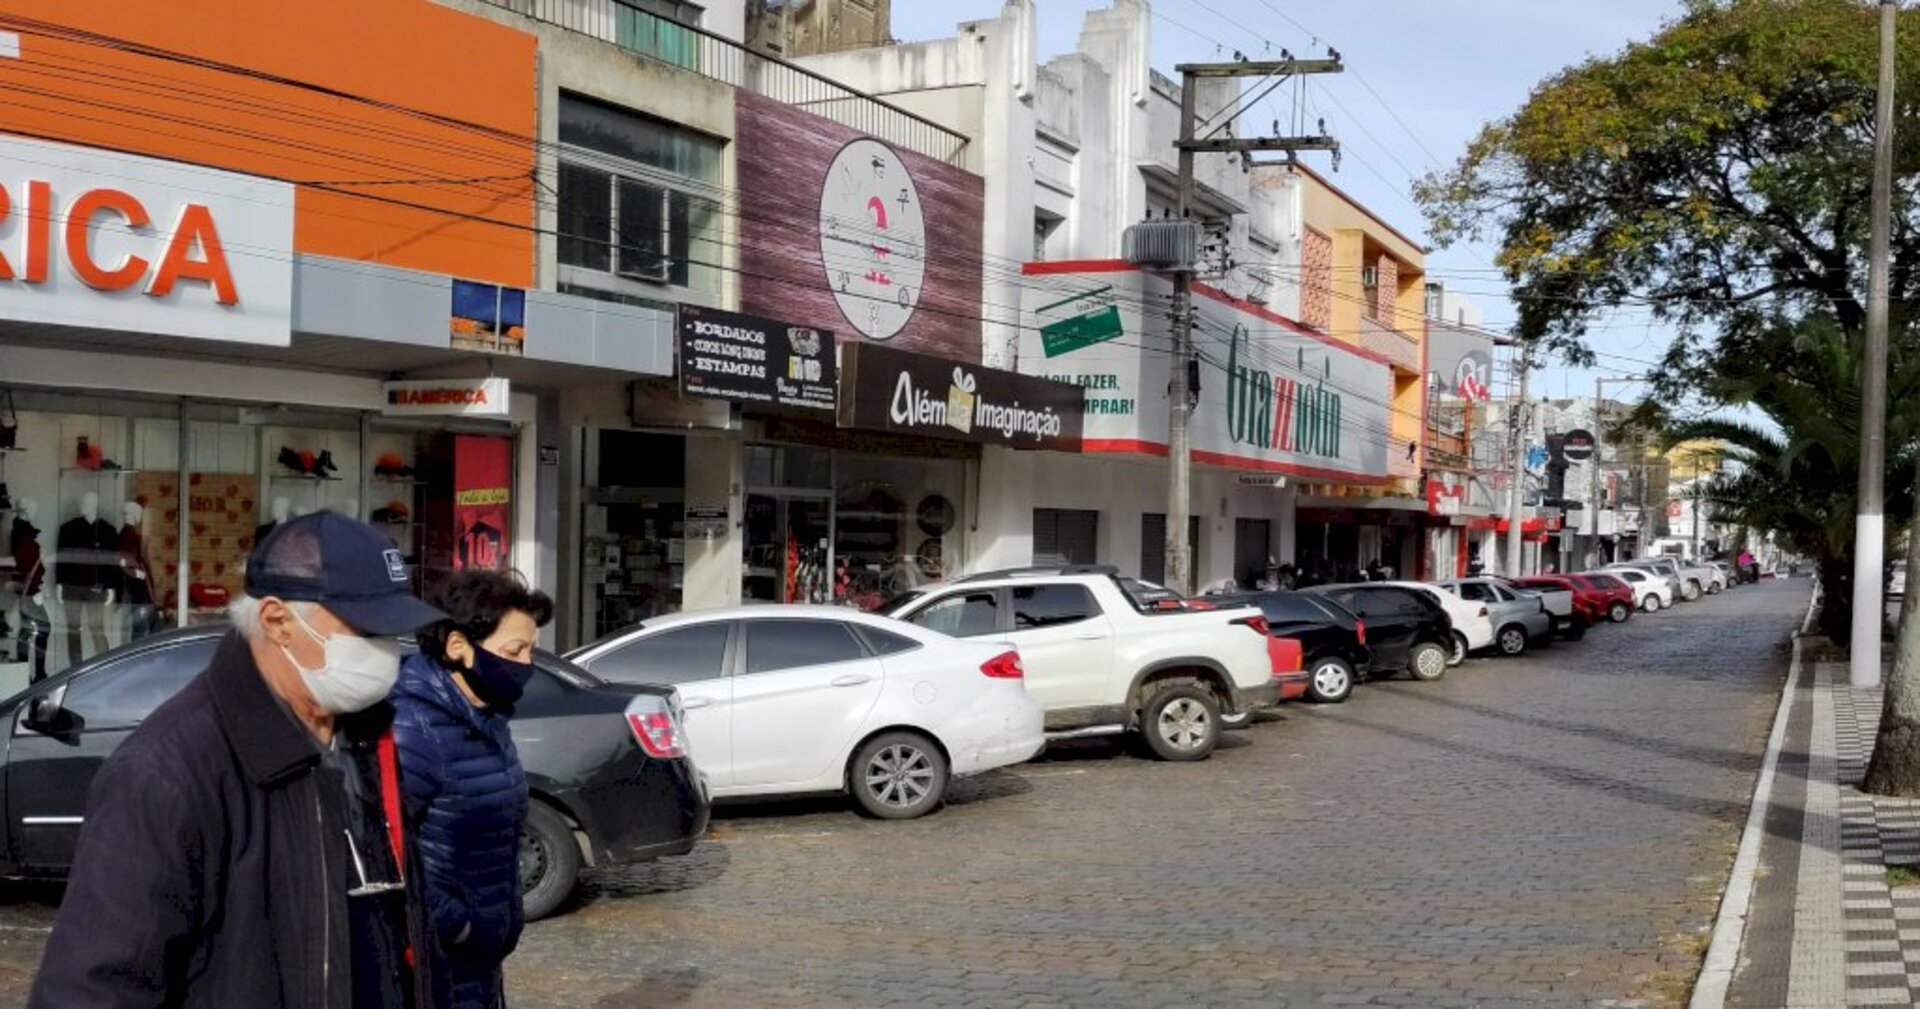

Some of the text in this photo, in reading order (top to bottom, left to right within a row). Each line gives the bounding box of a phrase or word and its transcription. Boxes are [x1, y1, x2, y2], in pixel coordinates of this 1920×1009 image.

[693, 320, 766, 344] BORDADOS
[695, 357, 766, 378] ESTAMPAS
[890, 370, 947, 426] Além
[976, 394, 1061, 441] Imaginação
